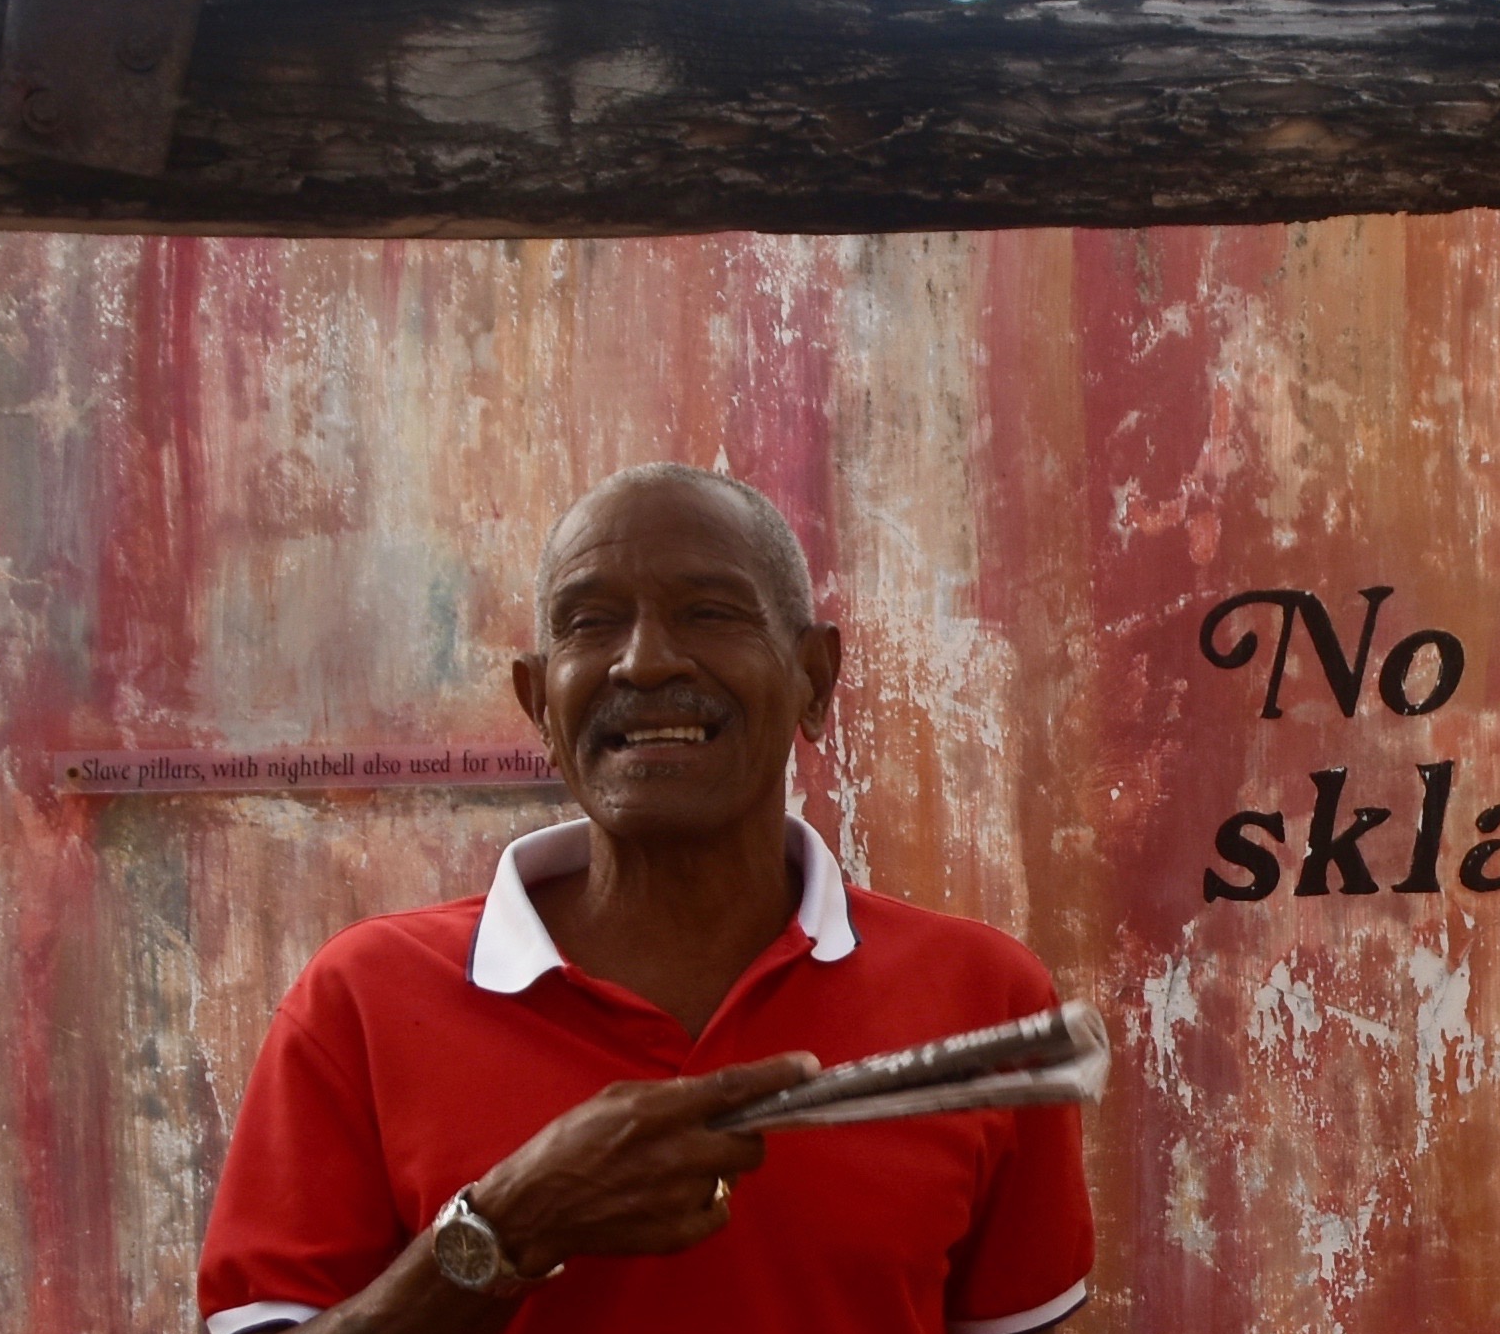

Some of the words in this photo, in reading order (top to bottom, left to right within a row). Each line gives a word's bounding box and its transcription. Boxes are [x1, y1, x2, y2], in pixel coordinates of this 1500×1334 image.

[1199, 585, 1465, 720] No
[81, 757, 131, 782] Slave
[138, 756, 206, 787] pillars,
[212, 754, 258, 779] with
[267, 751, 355, 785] nightbell
[363, 752, 401, 776] also
[410, 750, 450, 774] used
[463, 748, 490, 773] for
